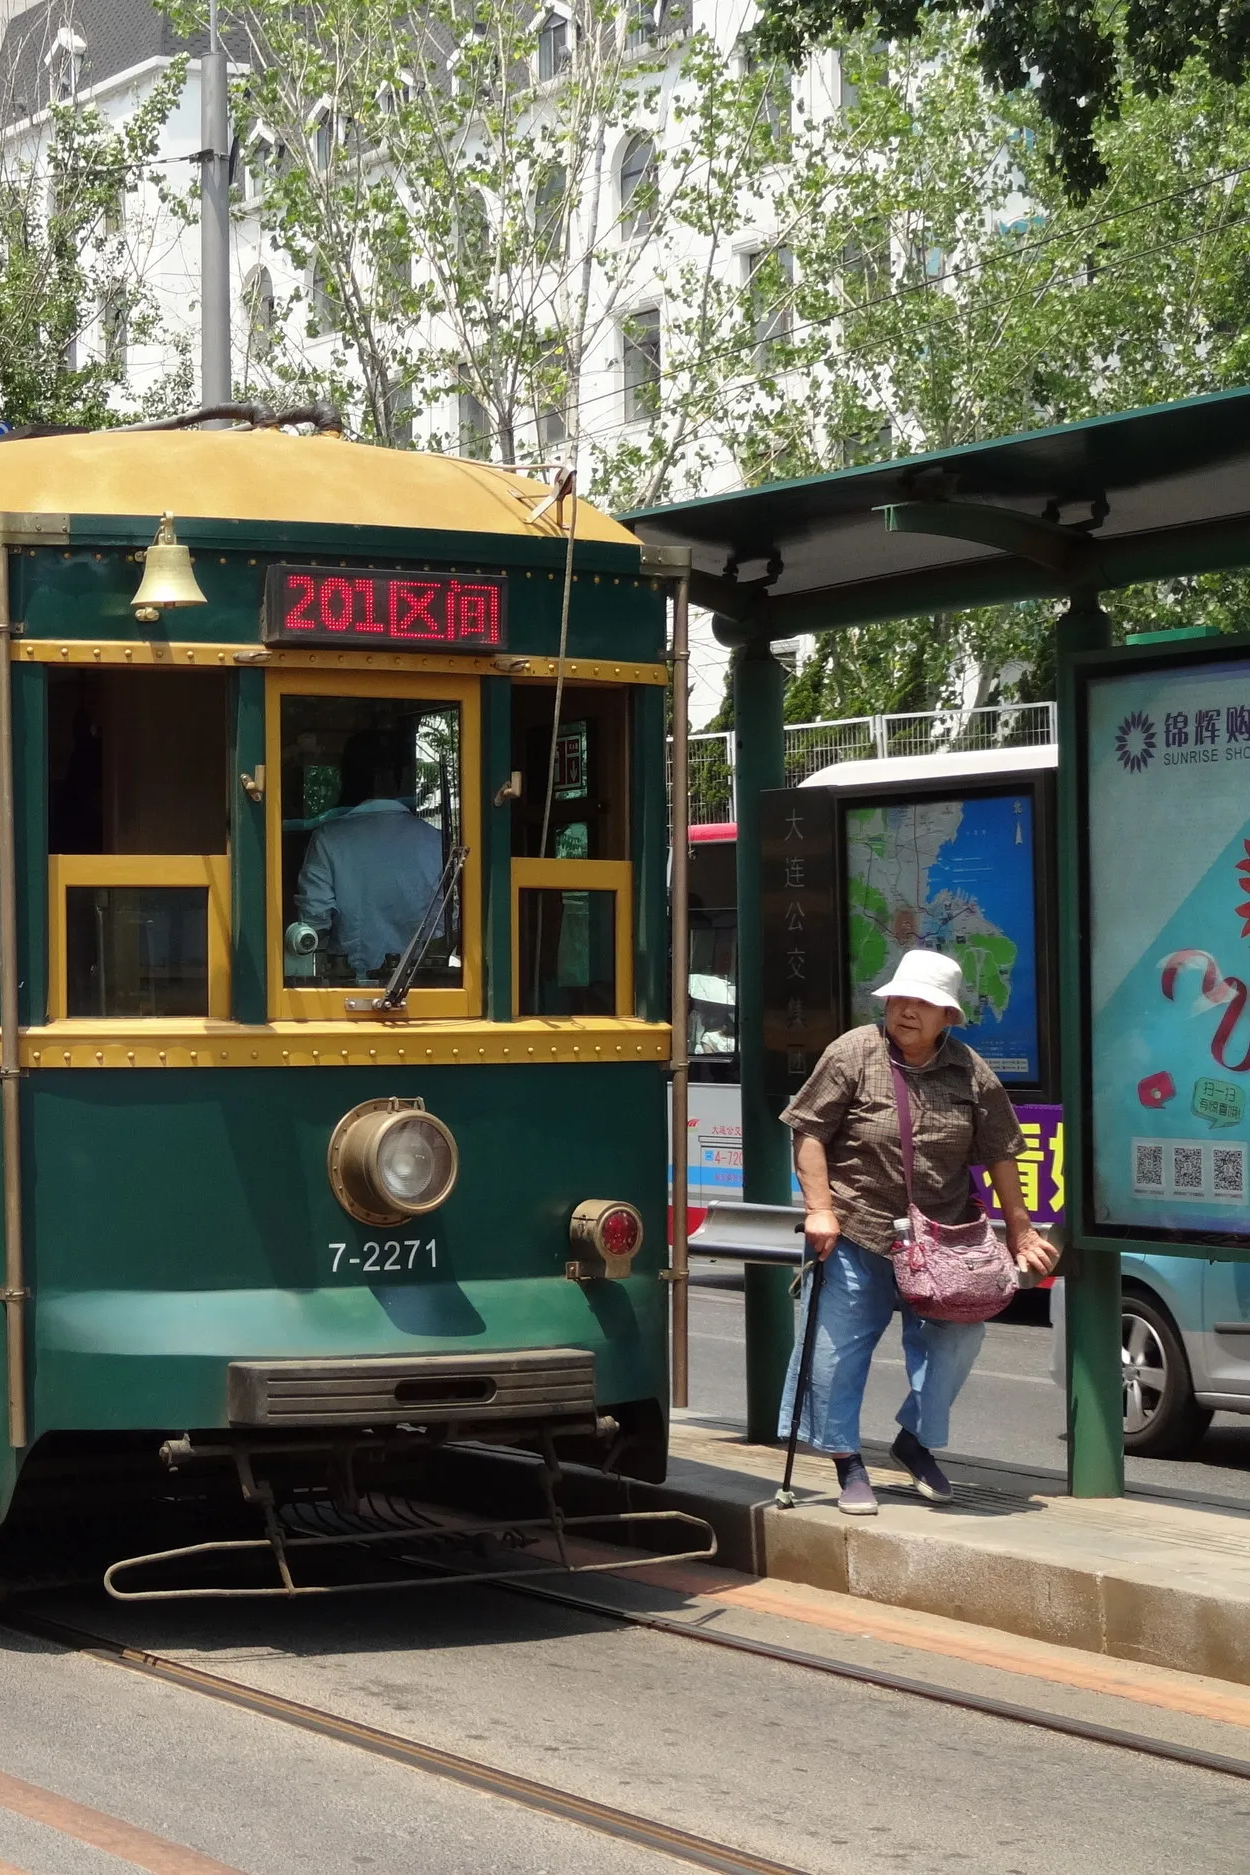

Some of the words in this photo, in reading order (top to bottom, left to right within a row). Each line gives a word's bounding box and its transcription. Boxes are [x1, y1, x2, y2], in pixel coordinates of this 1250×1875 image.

[285, 576, 499, 643] 201区间
[1163, 749, 1219, 765] SUNRISE
[784, 808, 806, 1075] 大连公交集团
[1203, 1081, 1236, 1102] 扫一扫
[328, 1239, 437, 1271] 7-2271
